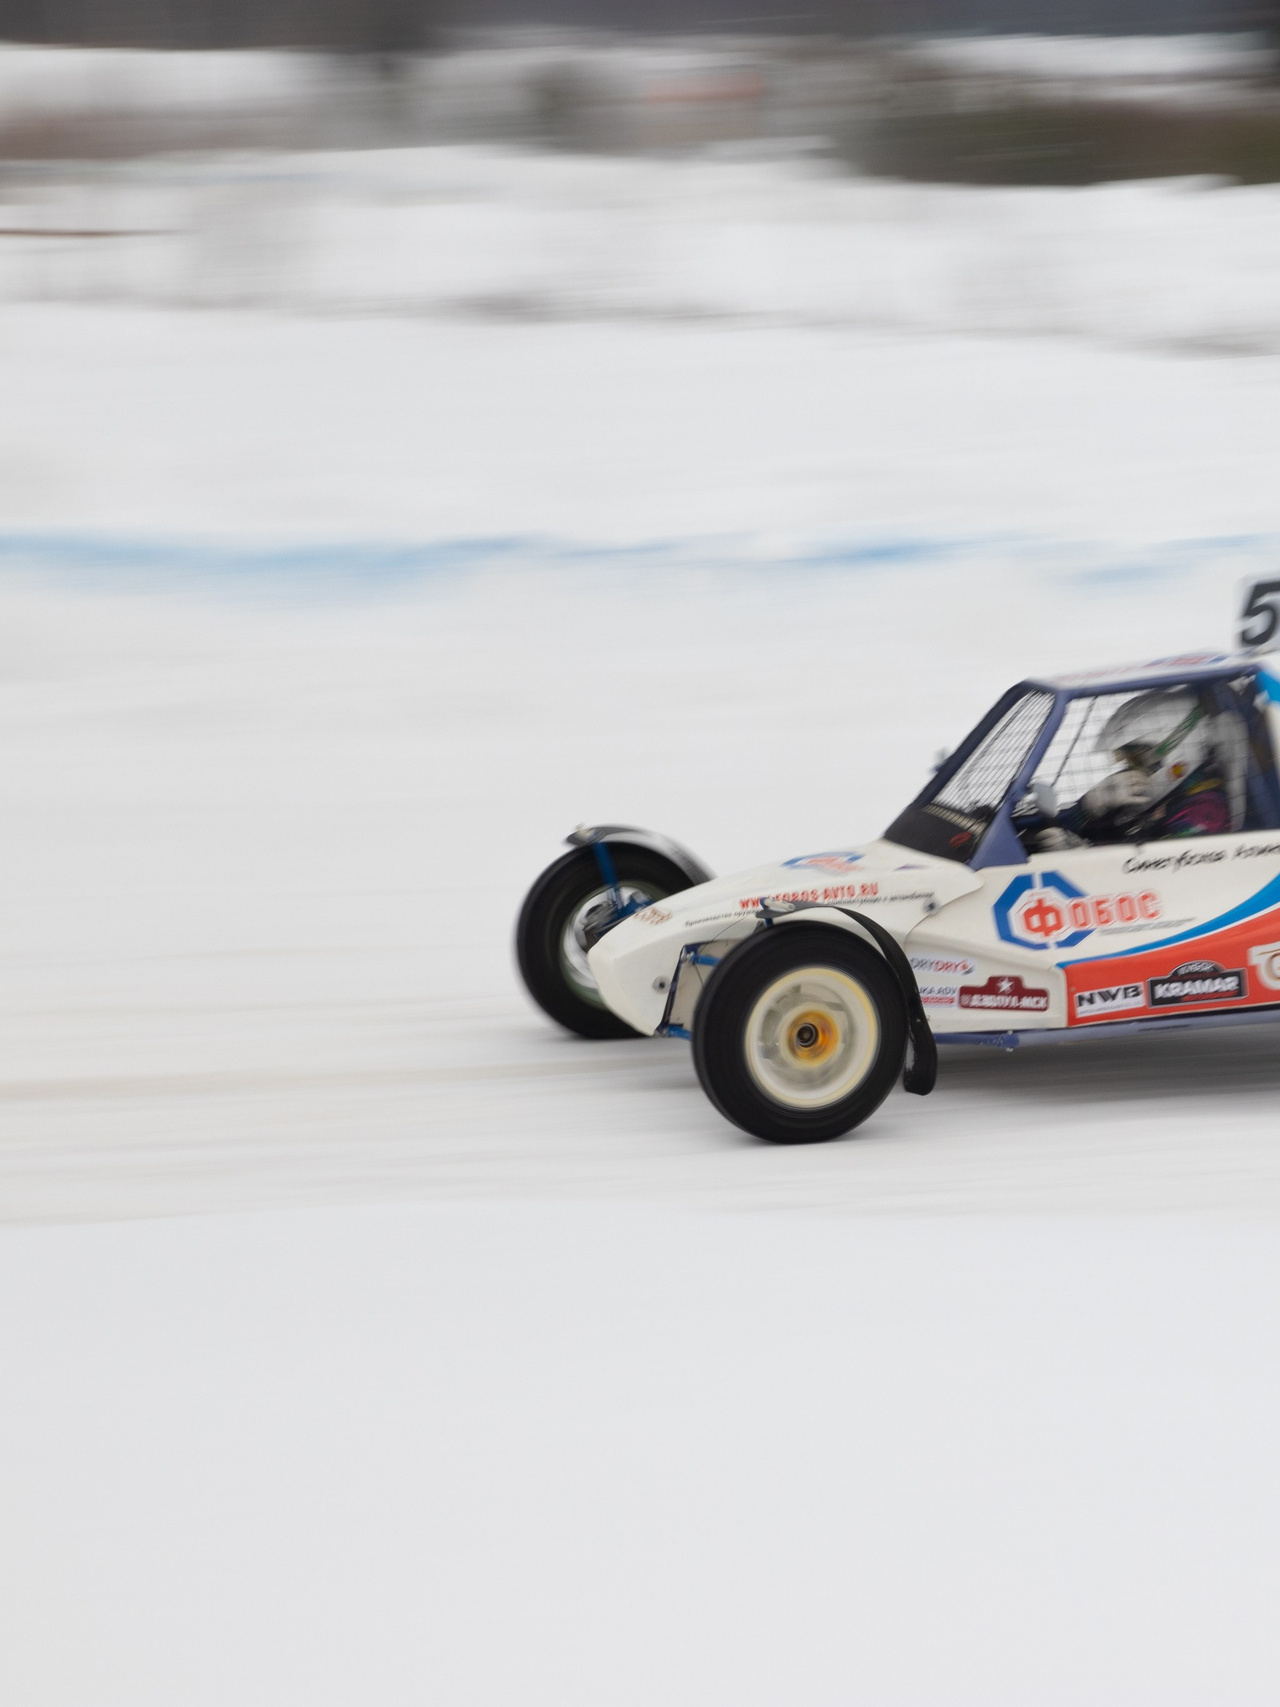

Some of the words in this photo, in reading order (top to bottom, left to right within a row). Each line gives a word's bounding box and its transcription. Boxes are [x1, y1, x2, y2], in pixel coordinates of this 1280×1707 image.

[1022, 889, 1162, 938] ФОБОС
[1078, 984, 1143, 1007] NWB
[1154, 976, 1240, 1000] KRAMAR
